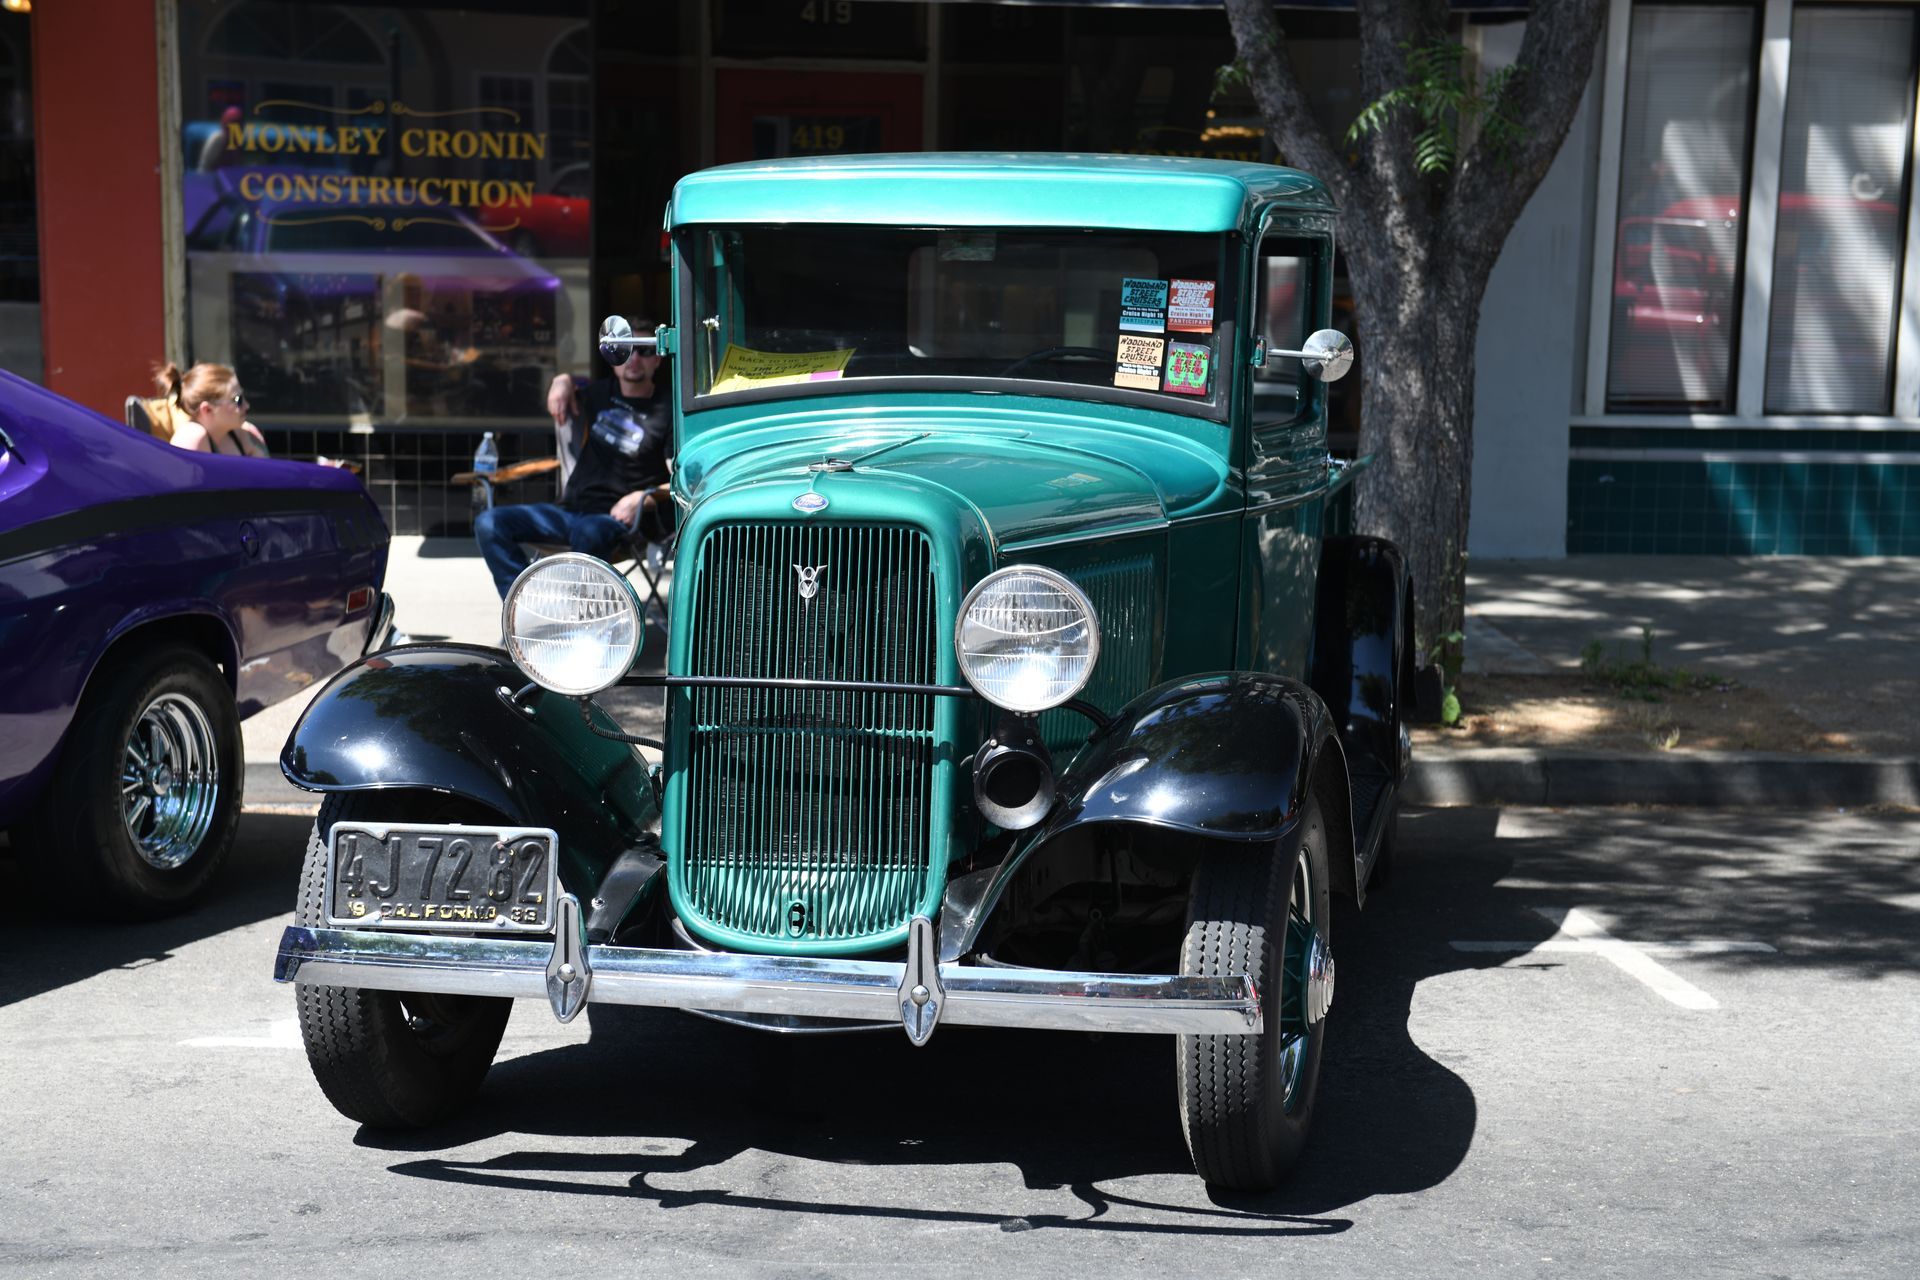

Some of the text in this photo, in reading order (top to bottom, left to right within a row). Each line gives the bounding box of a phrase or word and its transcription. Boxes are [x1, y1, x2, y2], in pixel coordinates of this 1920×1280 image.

[800, 0, 851, 24] 419
[227, 123, 547, 161] MONLEY CRONIN
[792, 125, 845, 149] 419
[240, 173, 535, 208] CONSTRUCTION
[1120, 337, 1162, 348] WOODLAND
[1126, 346, 1155, 355] STREET
[1120, 353, 1157, 364] CRUISERS
[380, 902, 497, 920] CALIFORNIA
